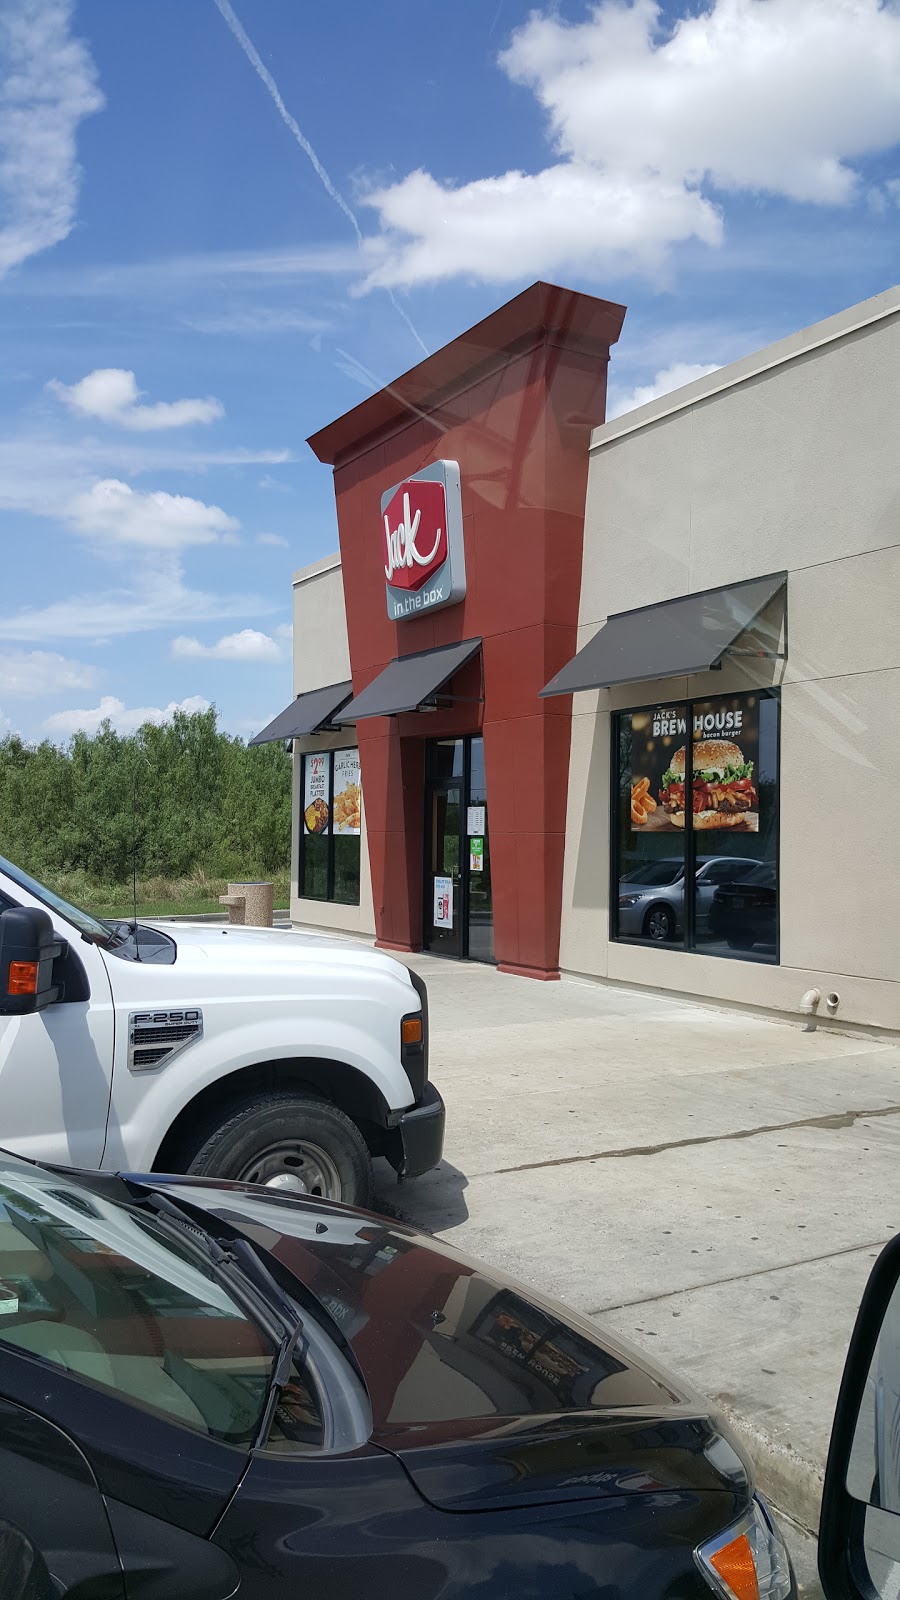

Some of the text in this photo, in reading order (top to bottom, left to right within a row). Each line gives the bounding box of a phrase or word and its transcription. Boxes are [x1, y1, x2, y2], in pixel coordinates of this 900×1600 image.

[384, 492, 441, 581] Jack
[394, 590, 443, 616] in the box
[653, 711, 676, 720] JACK'S
[653, 711, 743, 737] BREW HOUSE
[703, 730, 742, 738] bacon burger
[135, 1012, 198, 1024] F-250
